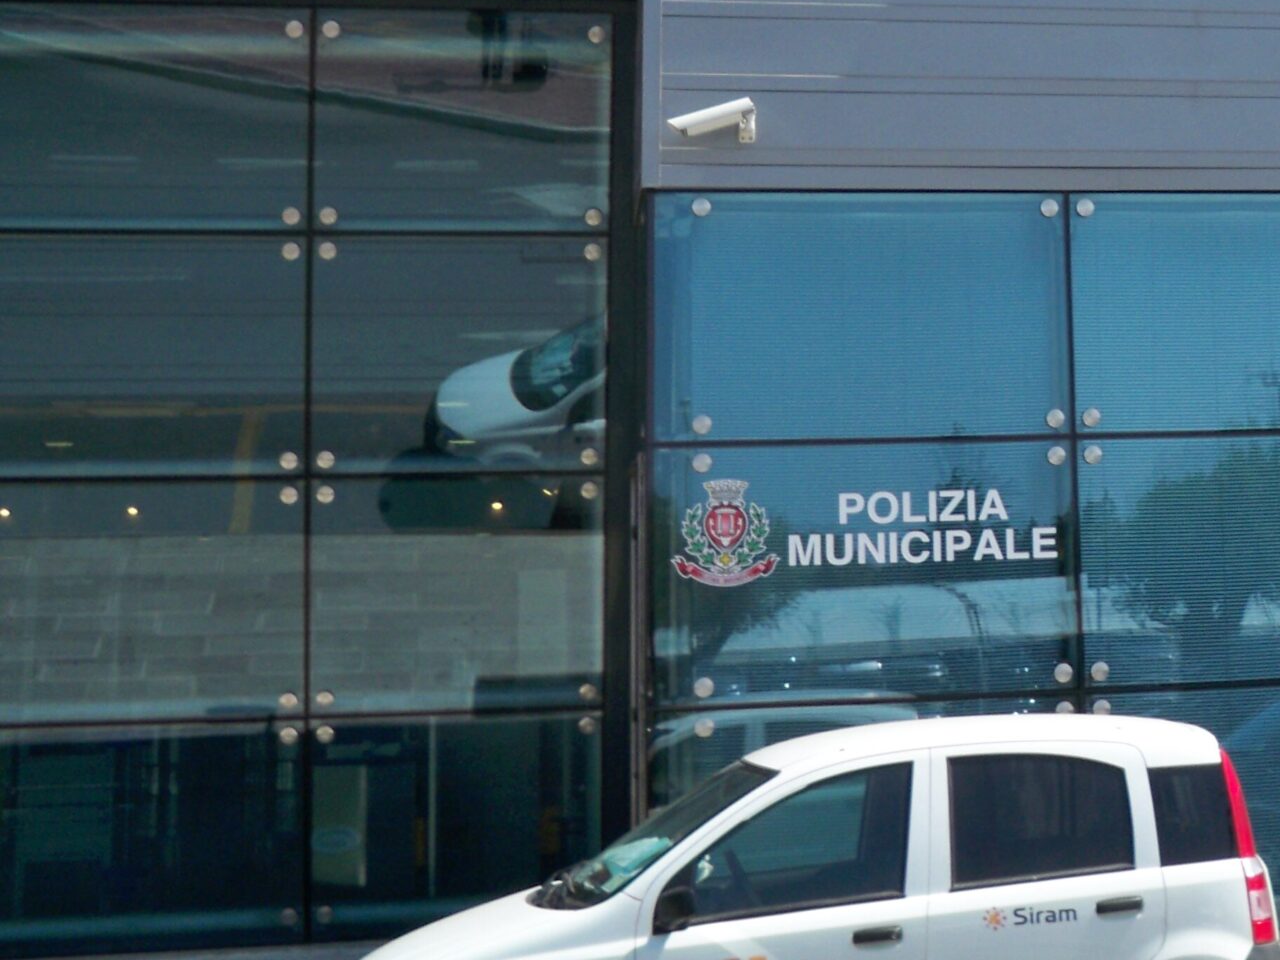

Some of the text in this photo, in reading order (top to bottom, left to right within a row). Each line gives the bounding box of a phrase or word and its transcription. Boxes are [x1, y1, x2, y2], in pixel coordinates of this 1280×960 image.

[838, 489, 1009, 524] POLIZIA
[788, 527, 1058, 566] MUNICIPALE
[1013, 907, 1078, 926] Siram
